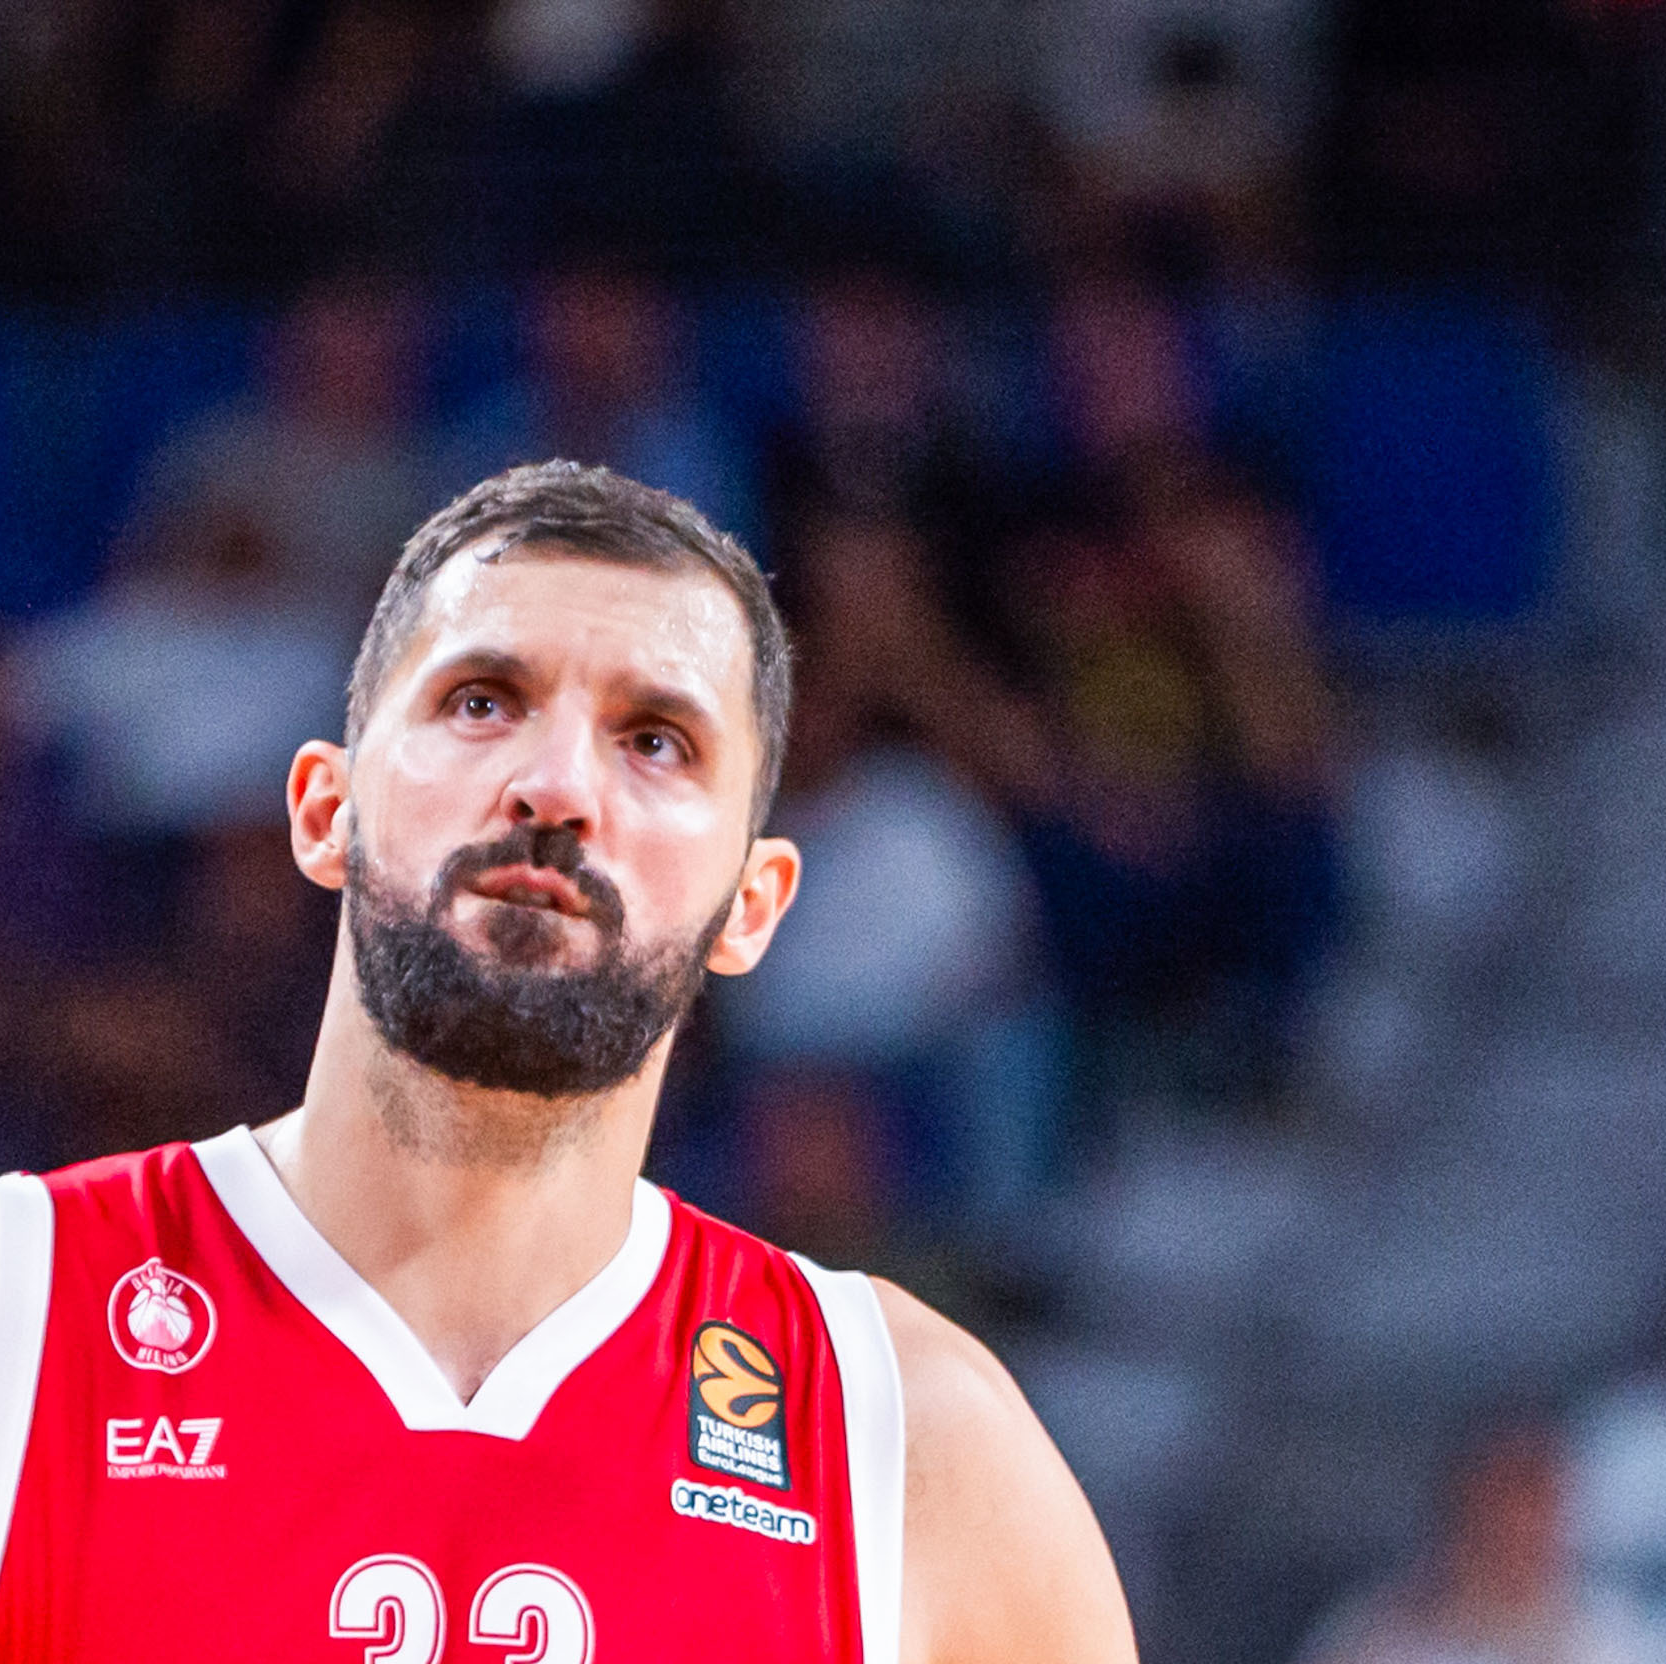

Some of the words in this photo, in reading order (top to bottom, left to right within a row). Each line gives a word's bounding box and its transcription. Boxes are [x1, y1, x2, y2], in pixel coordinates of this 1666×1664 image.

[106, 1416, 223, 1465] EA7
[697, 1415, 780, 1457] TURKISH
[697, 1432, 782, 1472] AIRLINES
[697, 1447, 783, 1487] EuroLeague
